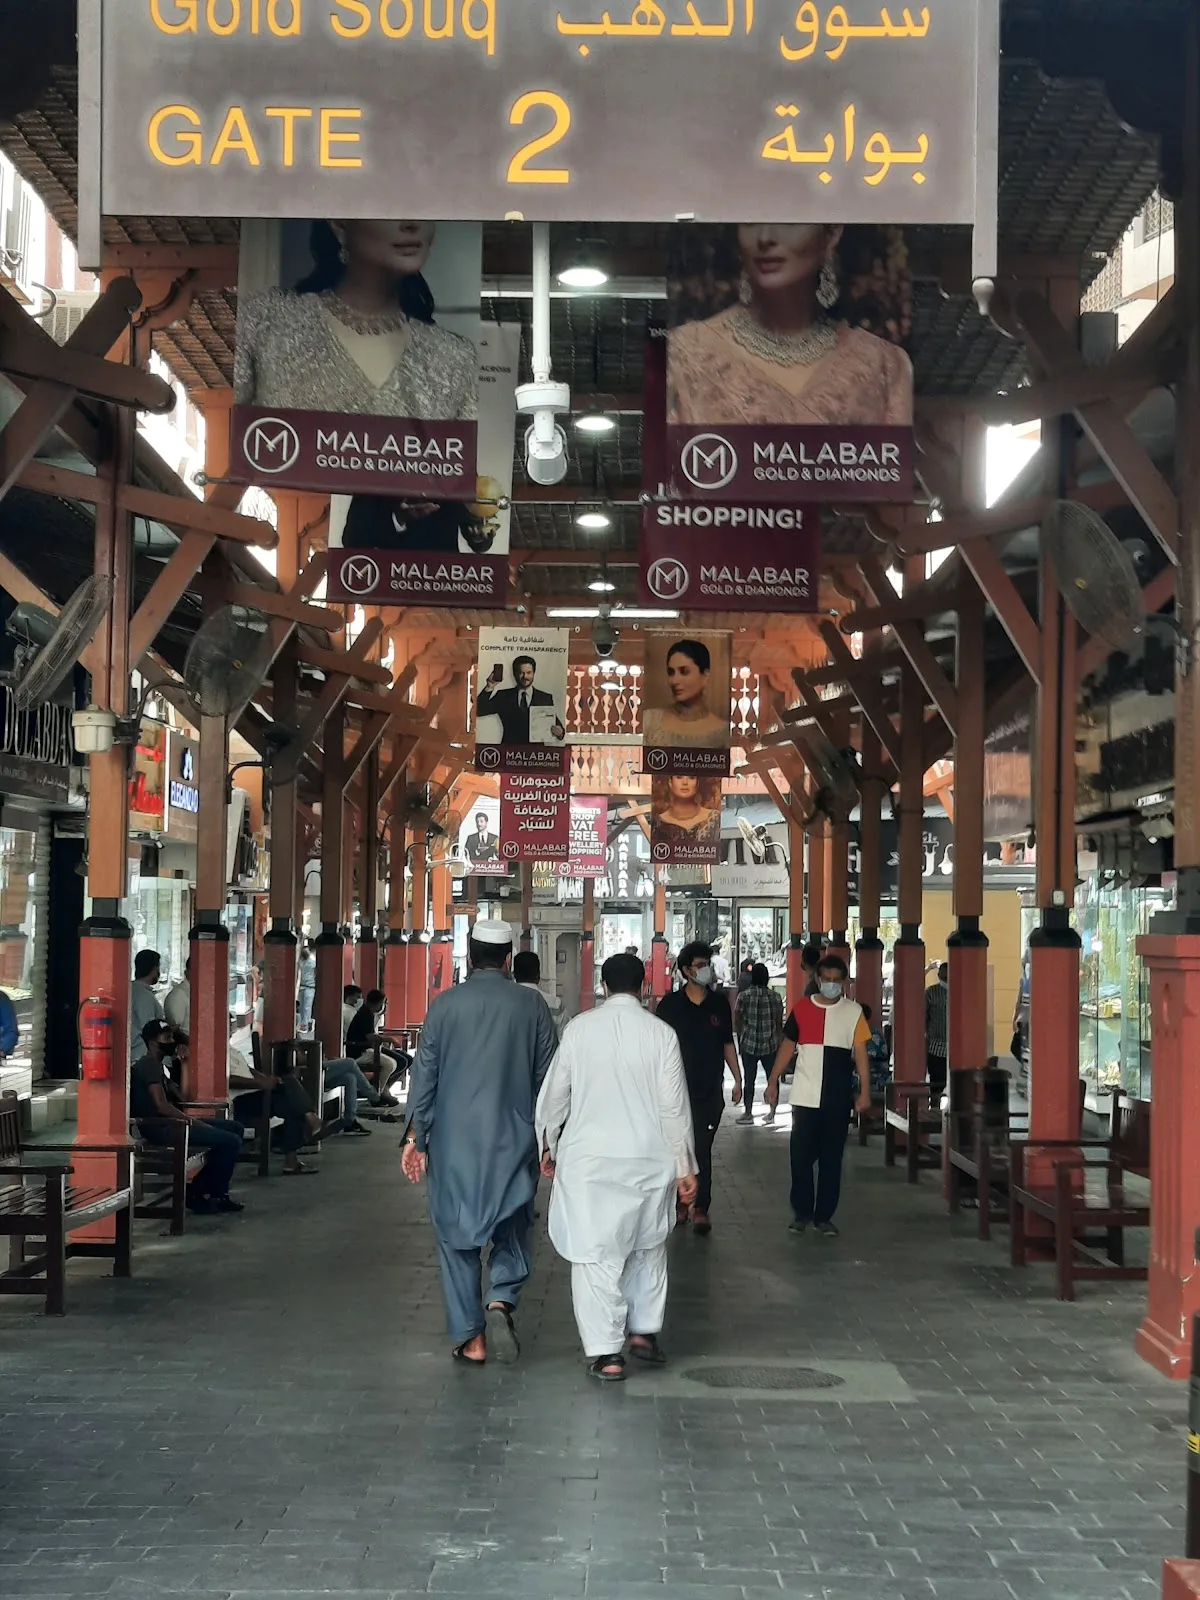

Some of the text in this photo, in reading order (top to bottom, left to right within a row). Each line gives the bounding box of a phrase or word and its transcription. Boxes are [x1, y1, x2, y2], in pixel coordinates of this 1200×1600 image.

[150, 0, 495, 55] Gold Souq
[147, 89, 571, 183] GATE 2
[761, 103, 929, 185] بوابة
[316, 429, 464, 460] MALABAR
[753, 442, 900, 466] MALABAR
[316, 455, 464, 476] GOLD & DIAMONDS
[753, 467, 901, 482] GOLD & DIAMONDS
[656, 505, 804, 530] SHOPPING!
[390, 562, 494, 583] MALABAR
[700, 564, 809, 585] MALABAR
[390, 579, 494, 594] GOLD & DIAMONDS
[700, 583, 809, 597] GOLD & DIAMONDS
[505, 751, 560, 761] MALABAR
[673, 752, 727, 764] MALABAR
[510, 775, 564, 788] المجوهرات
[504, 790, 567, 802] بدون الضريبة
[514, 805, 557, 815] المضافة
[571, 821, 595, 831] VAT
[523, 843, 567, 851] MALABAR
[569, 841, 605, 849] WELLERY
[569, 848, 602, 856] OPPING!
[674, 845, 717, 854] MALABAR
